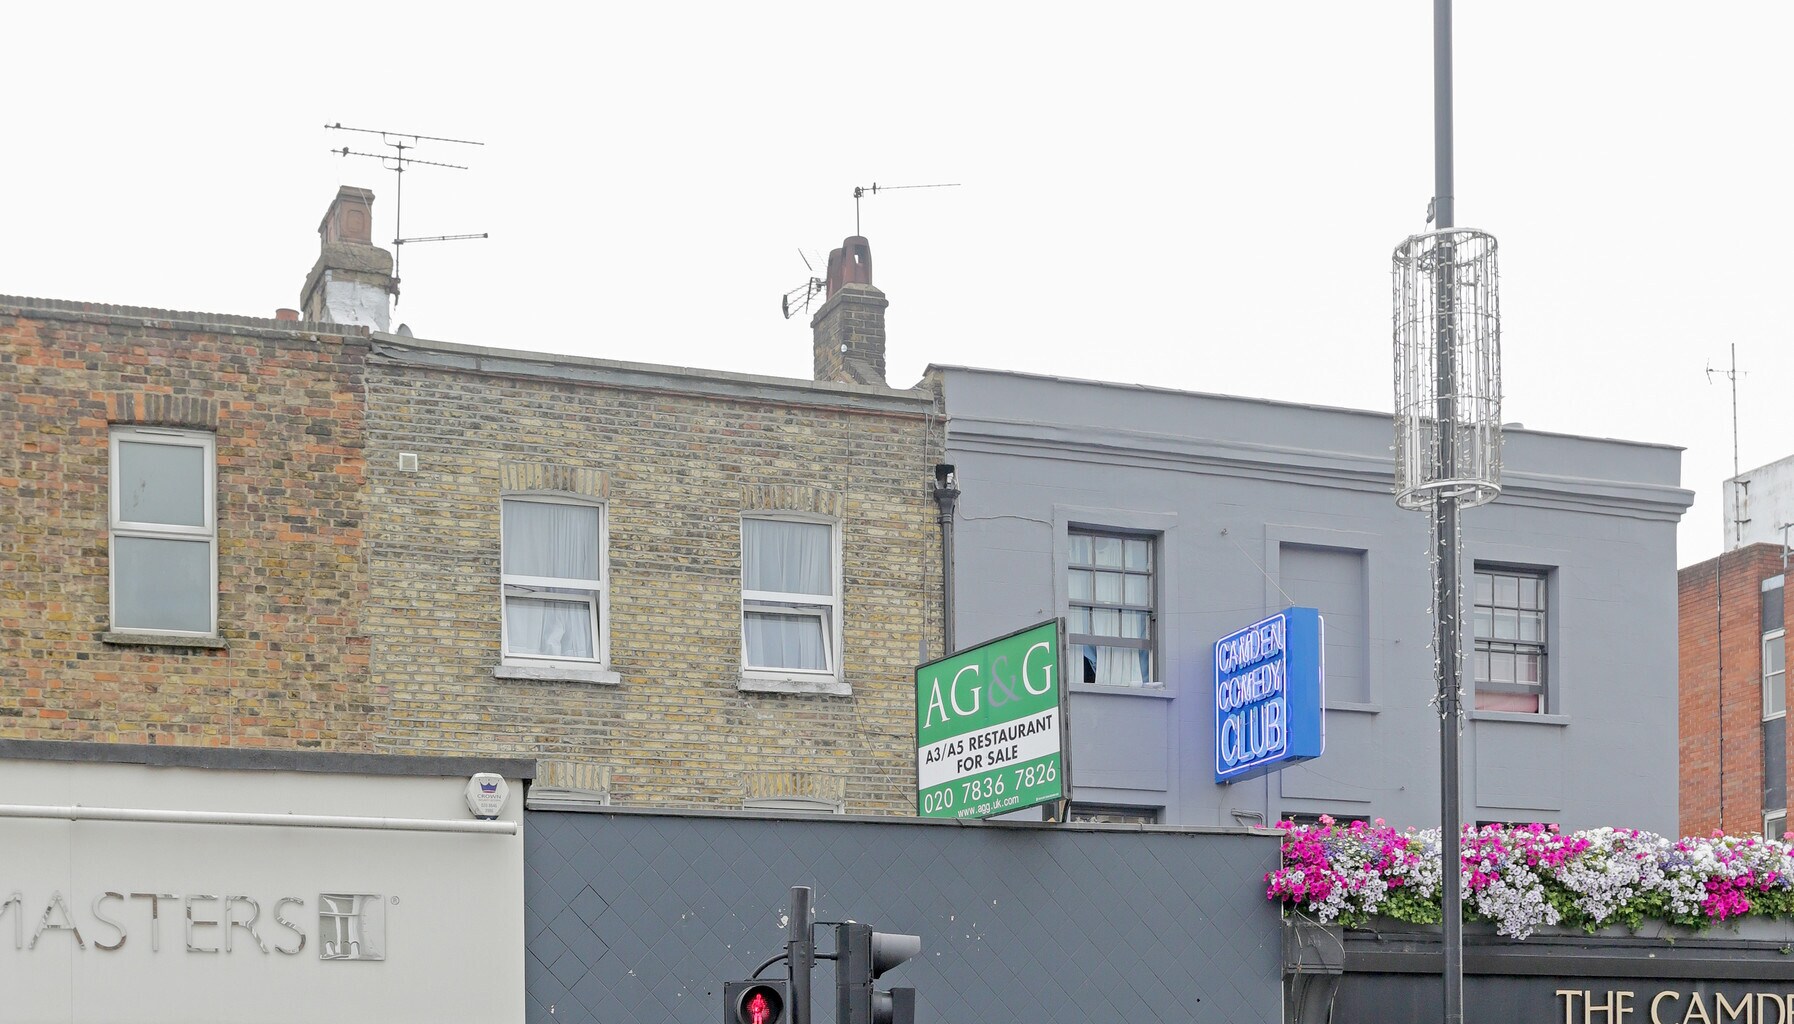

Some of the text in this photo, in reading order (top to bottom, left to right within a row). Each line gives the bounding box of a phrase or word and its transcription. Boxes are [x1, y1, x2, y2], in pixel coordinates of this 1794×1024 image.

[1219, 620, 1284, 672] CAMDEN
[1219, 659, 1284, 712] COMEDY
[926, 715, 1053, 764] A3/A5 RESTAURANT
[1221, 698, 1284, 766] CLUB
[957, 745, 1018, 774] FOR SALE
[924, 760, 1056, 814] 020 7836 7826
[957, 795, 1020, 818] www.agg.uk.com
